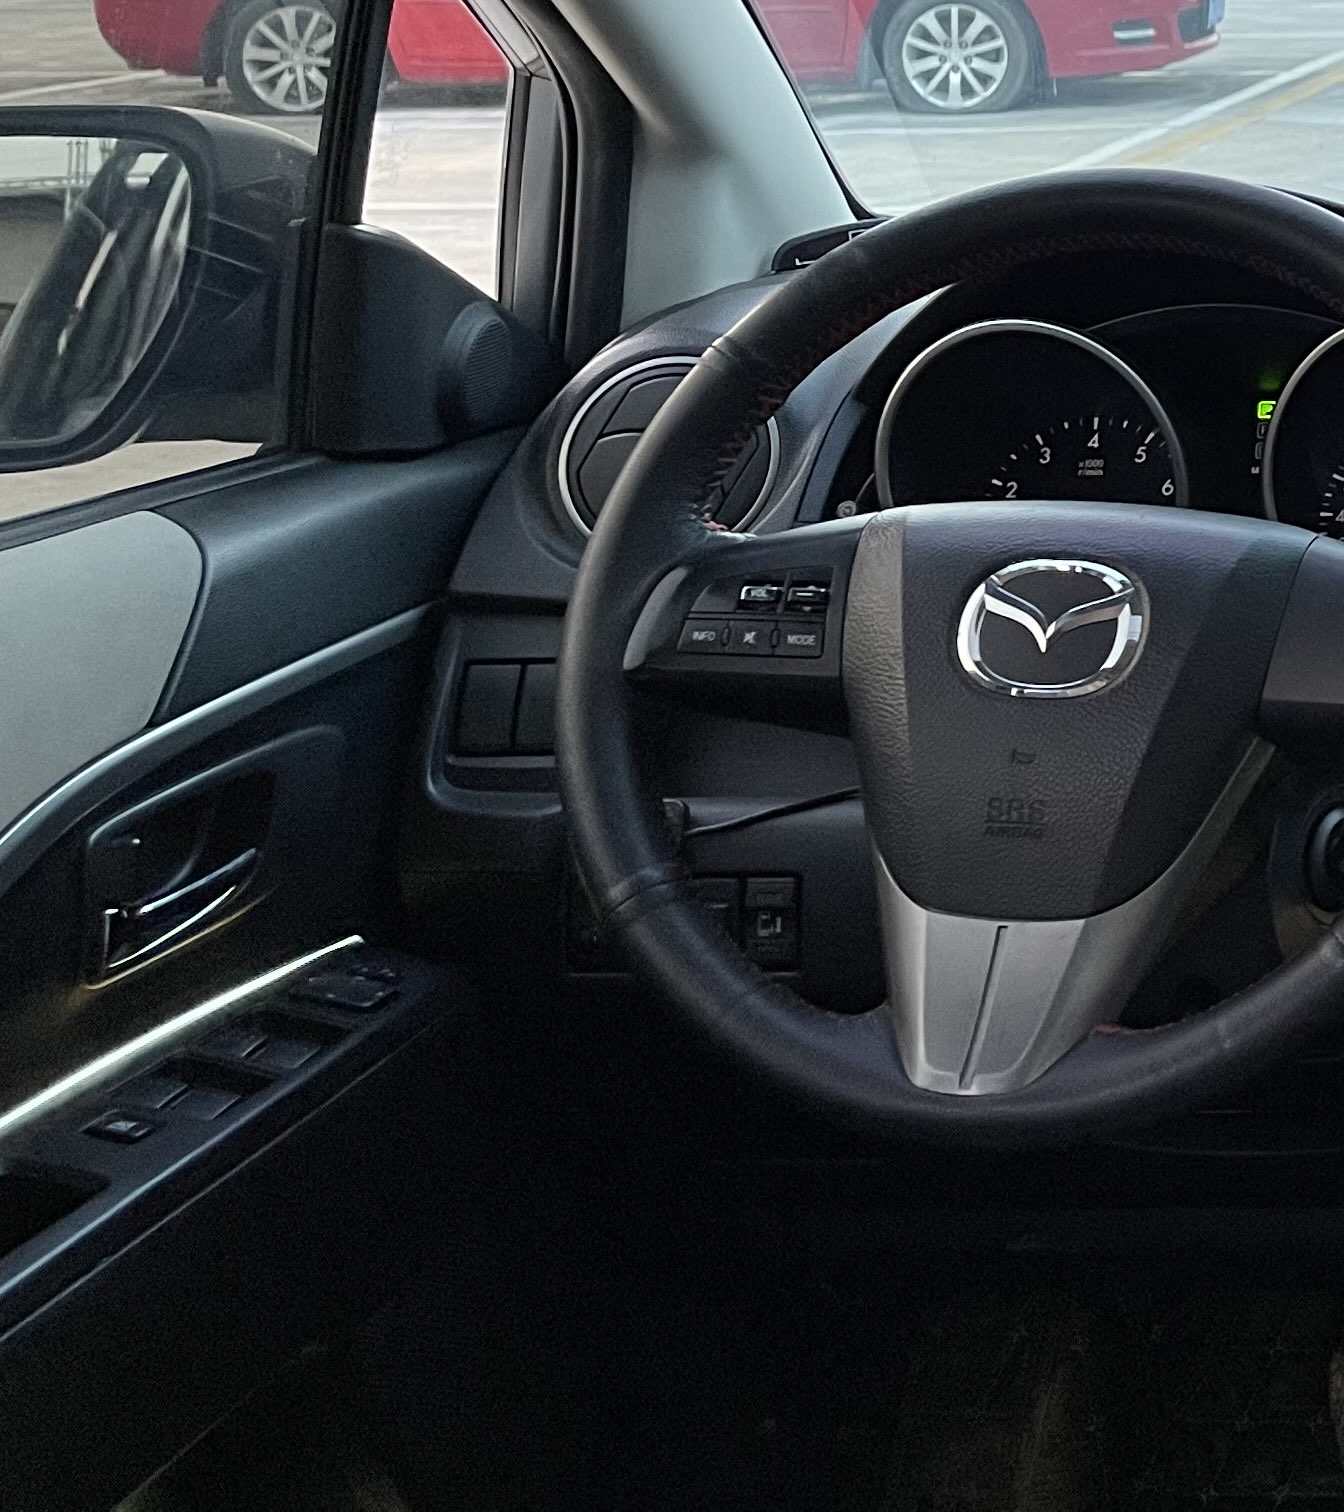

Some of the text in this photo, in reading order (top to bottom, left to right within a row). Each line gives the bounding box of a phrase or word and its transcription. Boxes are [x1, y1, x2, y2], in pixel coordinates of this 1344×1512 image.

[1087, 432, 1100, 449] 4
[1038, 446, 1051, 465] 3
[1133, 445, 1147, 464] 5
[1004, 480, 1019, 499] 2
[1160, 478, 1175, 497] 6
[692, 630, 717, 642] INFO
[786, 634, 817, 646] MODE
